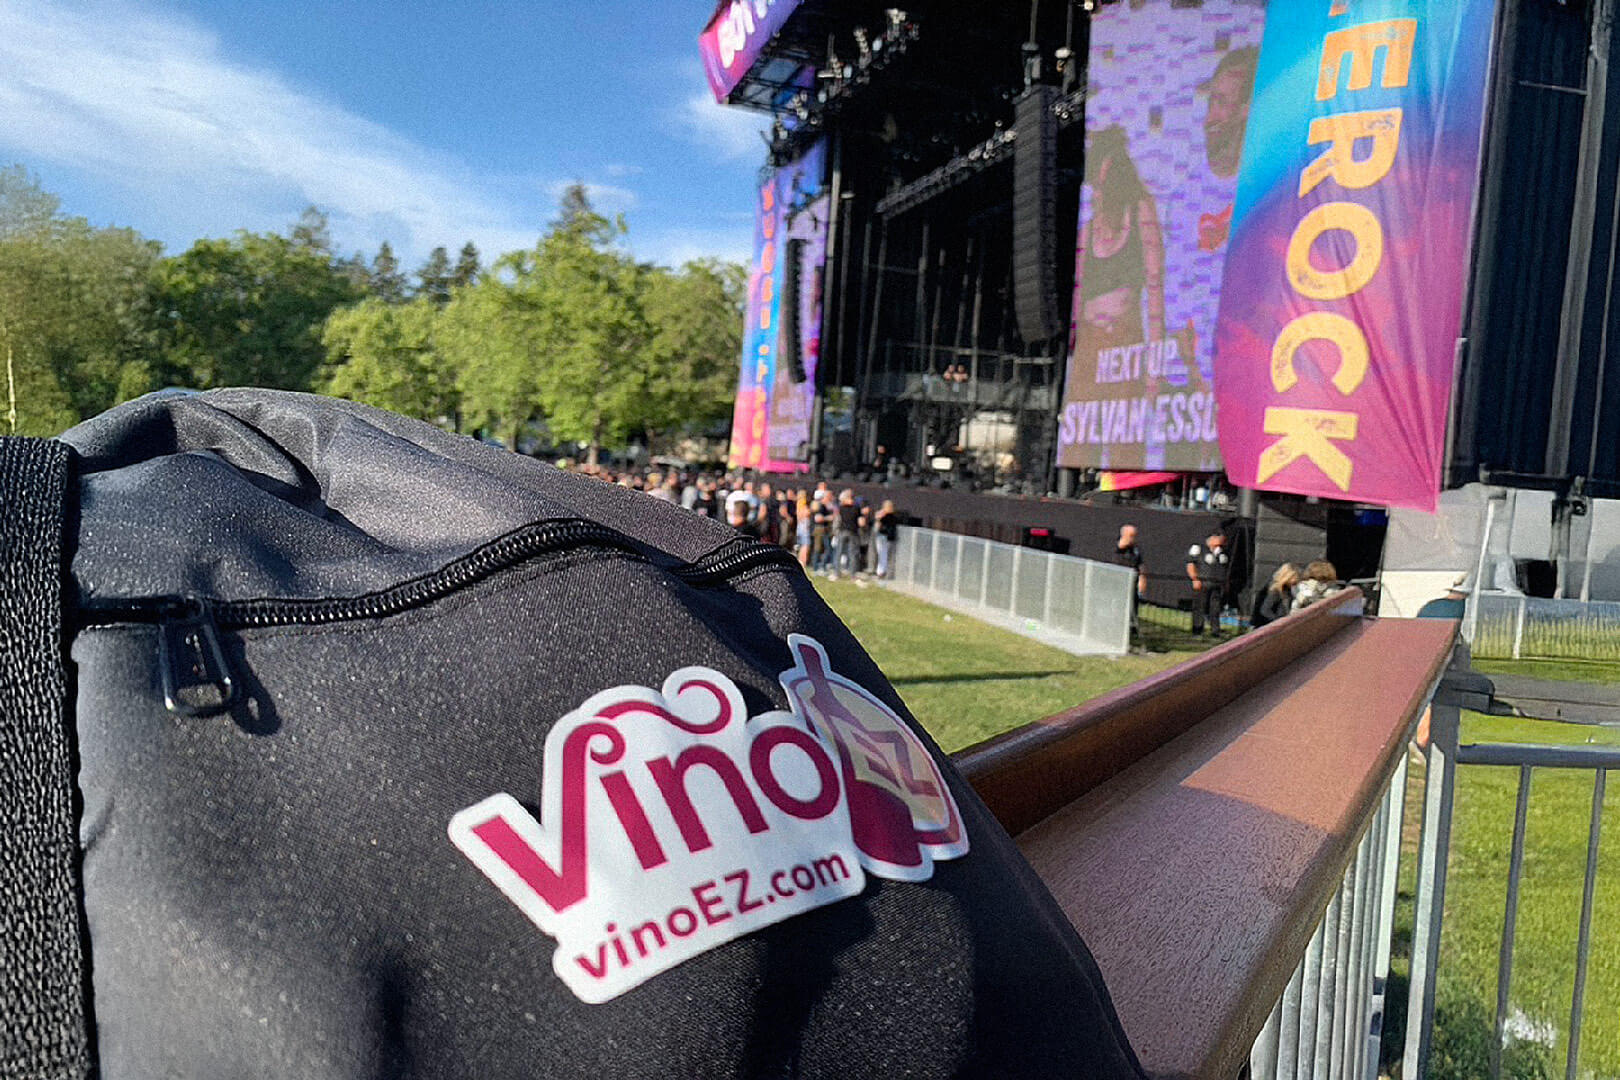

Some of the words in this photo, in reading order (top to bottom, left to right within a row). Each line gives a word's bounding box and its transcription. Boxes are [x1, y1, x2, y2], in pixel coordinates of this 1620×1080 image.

[1257, 0, 1417, 491] EROCK
[1096, 344, 1145, 383] NEXT
[1062, 398, 1147, 444] SYLVAN
[575, 852, 850, 978] vinoEZ.com
